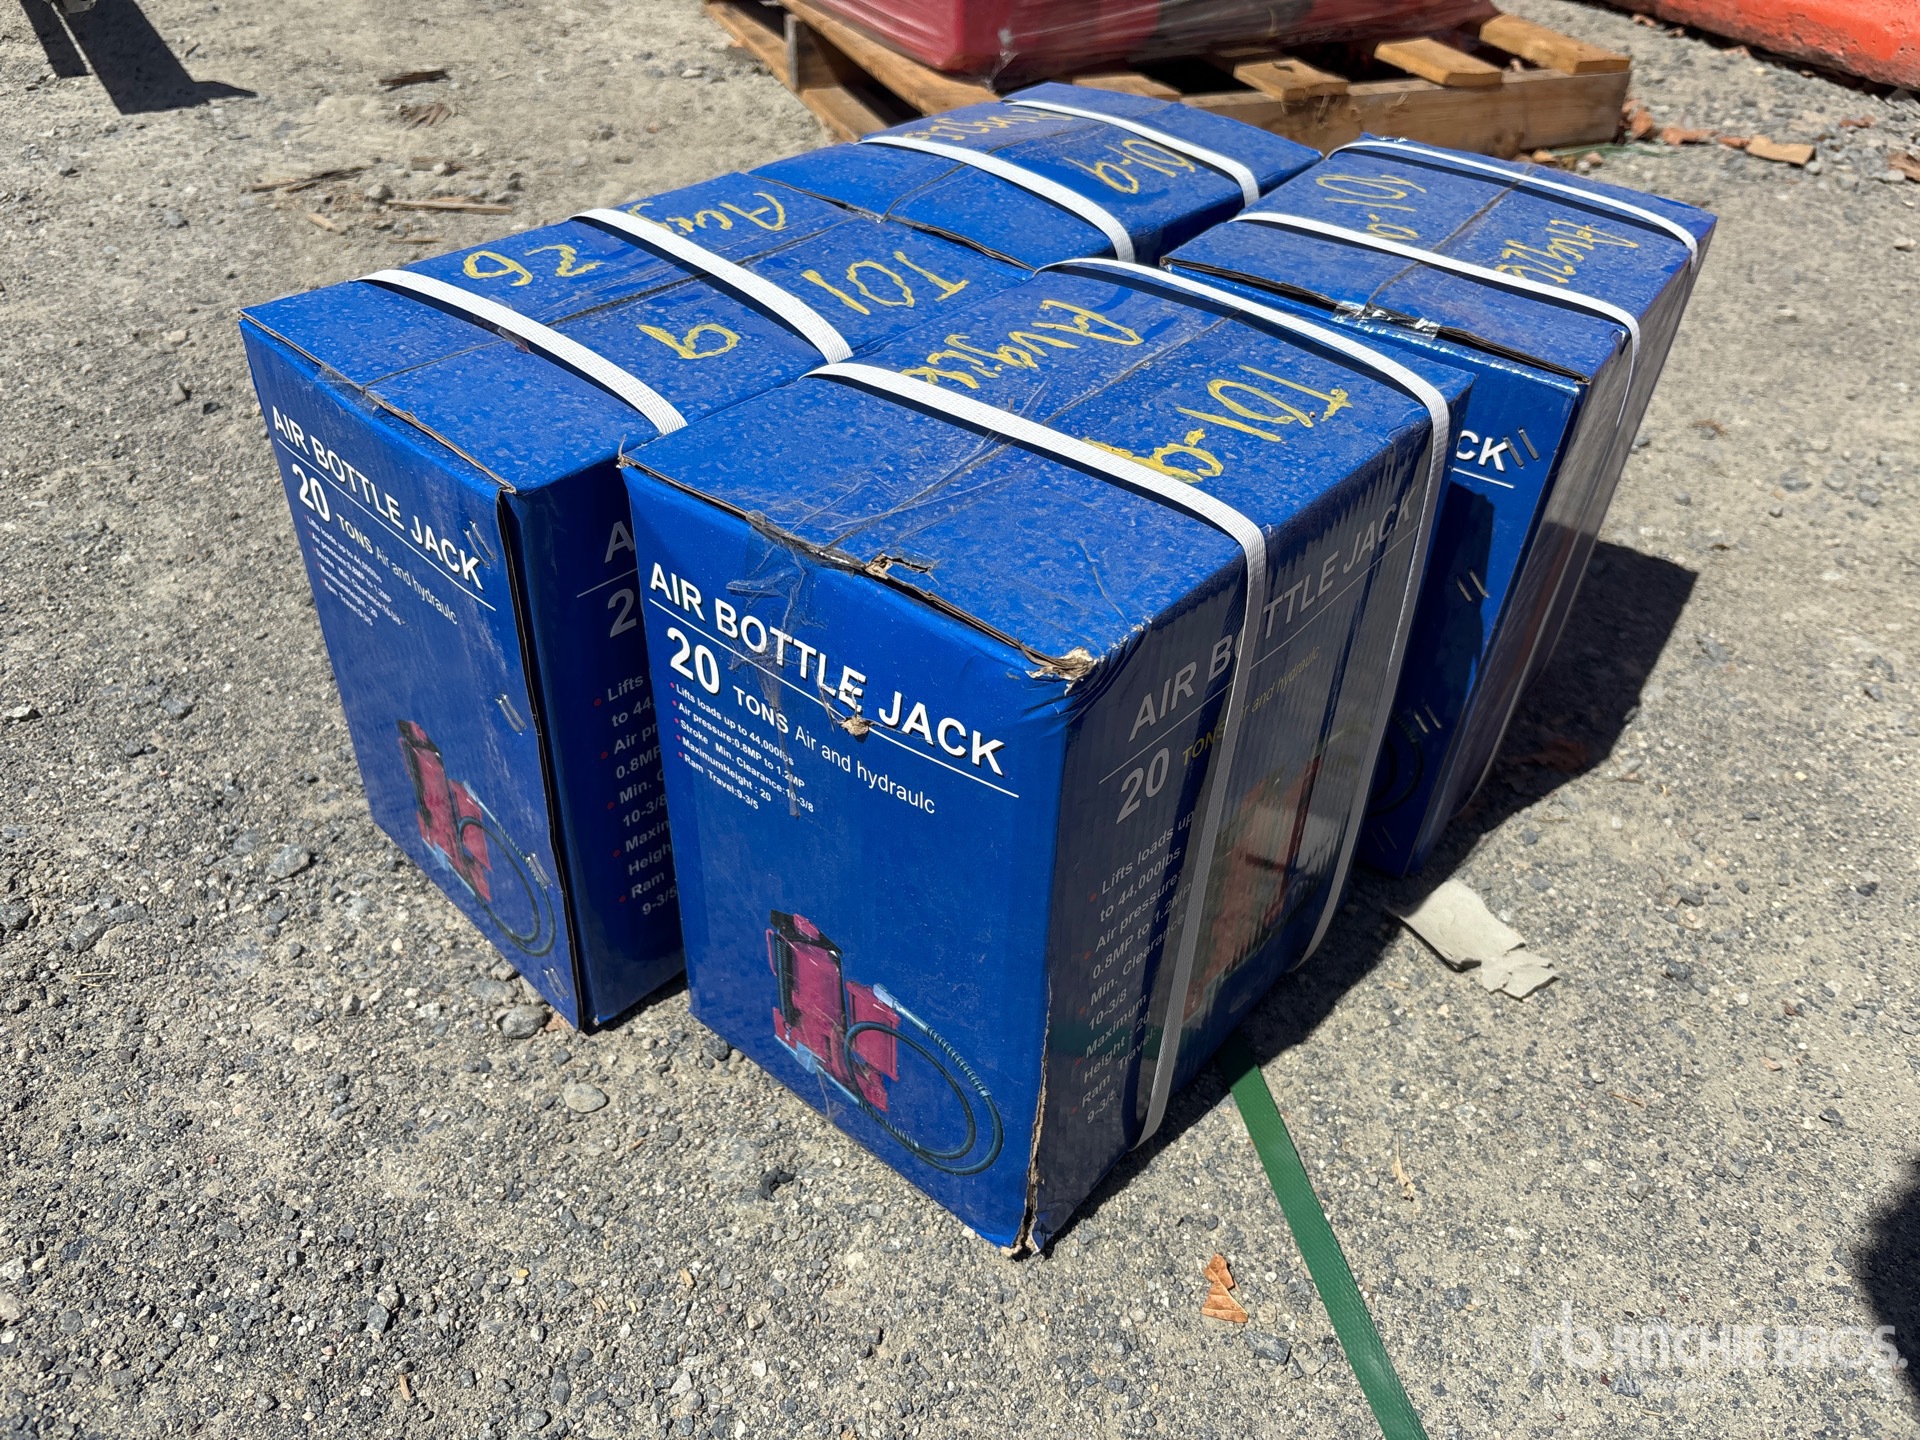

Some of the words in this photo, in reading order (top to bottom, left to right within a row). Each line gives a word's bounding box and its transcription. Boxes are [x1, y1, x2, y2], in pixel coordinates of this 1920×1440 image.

[1456, 430, 1508, 472] CK
[273, 405, 310, 456] AIR
[310, 435, 405, 531] BOTTLE
[411, 515, 484, 591] JACK
[292, 464, 331, 522] 20
[336, 513, 374, 554] TONS
[376, 546, 390, 569] Air
[391, 562, 412, 587] and
[607, 588, 637, 638] 2
[1128, 661, 1197, 743] AIR
[1208, 551, 1339, 682] BTTLE
[1343, 486, 1418, 574] JACK
[607, 676, 644, 702] Lifts
[650, 562, 706, 622] AIR
[715, 598, 866, 713] BOTTLE
[879, 691, 1005, 776] JACK
[612, 712, 629, 727] to
[667, 627, 720, 694] 20
[733, 685, 789, 733] TONS
[795, 726, 817, 751] Air
[822, 745, 851, 773] and
[857, 761, 935, 814] hydraulc
[676, 683, 695, 703] Lifts
[697, 698, 722, 720] loads
[724, 717, 736, 729] up
[737, 726, 747, 737] to
[614, 733, 637, 755] Air
[678, 702, 691, 716] Air
[764, 758, 774, 770] to
[777, 766, 805, 788] 1.2MP
[680, 720, 709, 745] Stroke
[715, 742, 735, 762] Min.
[684, 754, 704, 774] Ram
[1116, 748, 1170, 825] 20
[1183, 720, 1227, 767] TONS
[1251, 683, 1275, 713] and
[619, 781, 652, 804] Min.
[760, 789, 772, 802] 20
[628, 843, 672, 876] Heigh
[1102, 862, 1133, 895] Lifts
[1137, 827, 1174, 866] loads
[1177, 811, 1194, 831] up
[631, 871, 665, 899] Ram
[1100, 905, 1114, 922] to
[1118, 847, 1180, 906] 44,000lbs
[1093, 935, 1134, 979] 0.8MP
[1137, 923, 1150, 939] to
[1155, 883, 1192, 923] 1.2MP
[1095, 927, 1118, 953] Air
[1120, 870, 1182, 934] pressure:
[1088, 988, 1127, 1031] 10-3/8
[1091, 977, 1118, 1006] Min.
[1083, 1036, 1125, 1084] Height
[1135, 1011, 1150, 1032] 20
[1085, 994, 1146, 1058] Maximum
[1082, 1075, 1110, 1108] Ram
